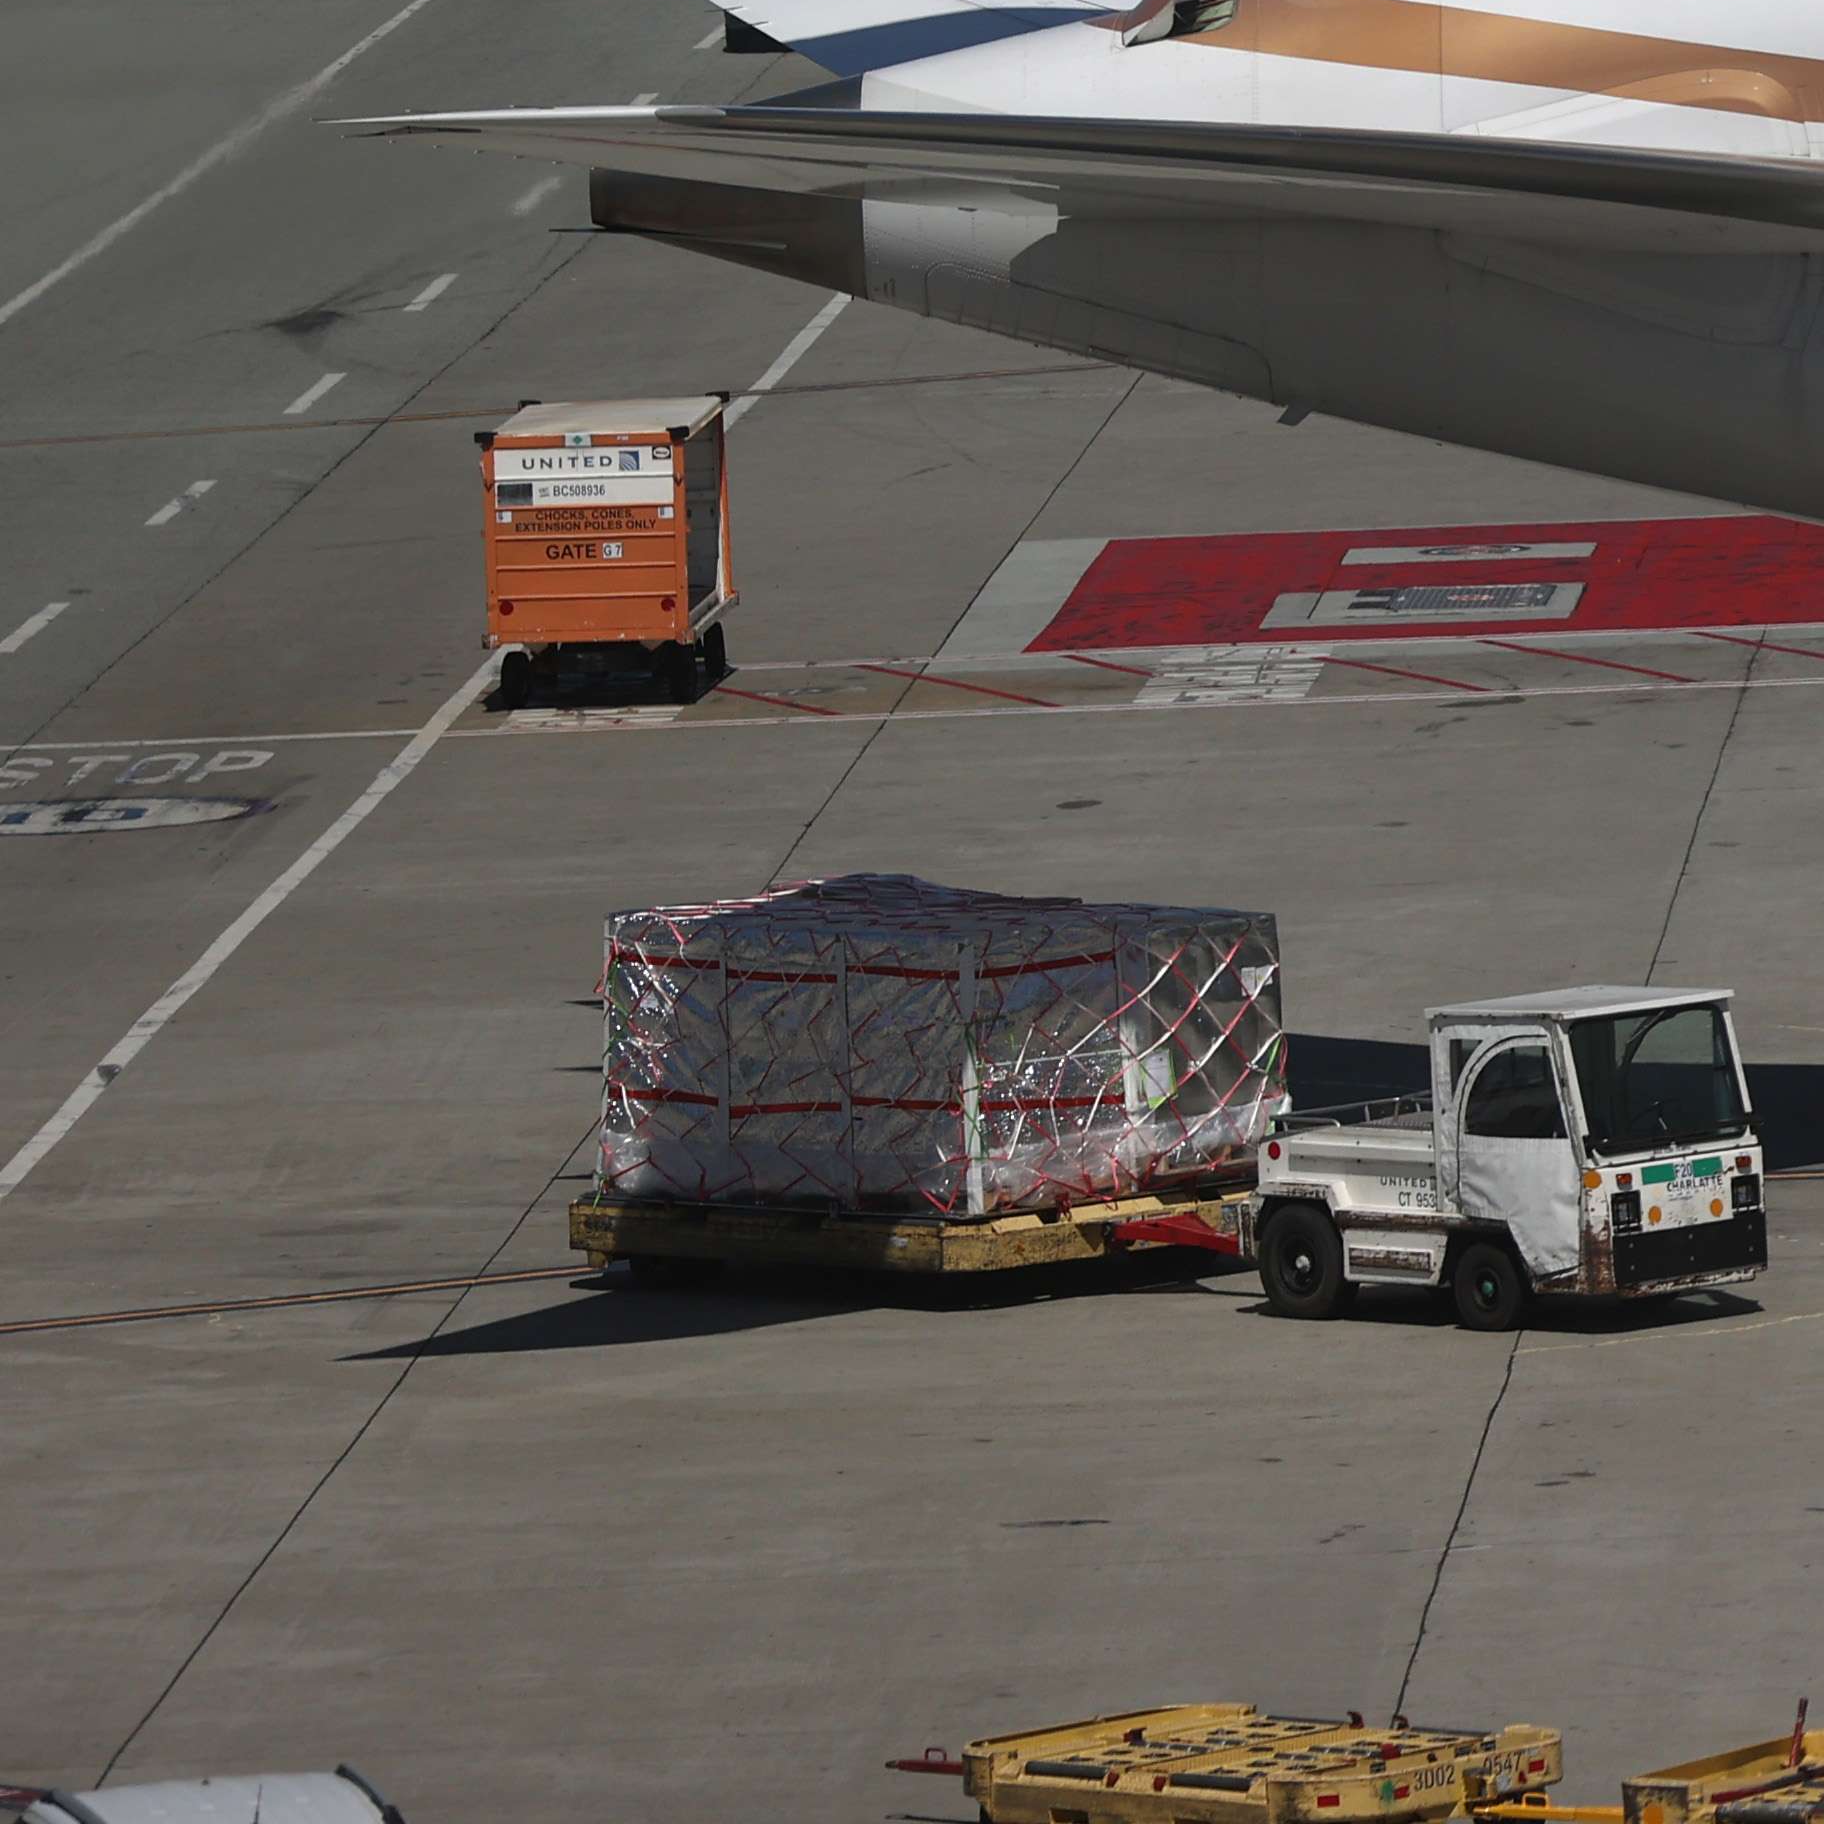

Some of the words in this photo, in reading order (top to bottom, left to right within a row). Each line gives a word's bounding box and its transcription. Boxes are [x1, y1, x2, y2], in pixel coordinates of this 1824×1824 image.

[522, 456, 613, 470] UNITED
[553, 484, 606, 497] BC508936
[515, 520, 581, 532] EXTENSION
[584, 519, 623, 530] POLES
[626, 519, 656, 529] ONLY
[546, 543, 597, 560] GATE
[0, 750, 275, 789] STOP
[1380, 1176, 1427, 1188] UNITED
[1667, 1174, 1723, 1192] CHARLATTE
[1398, 1191, 1411, 1207] CT
